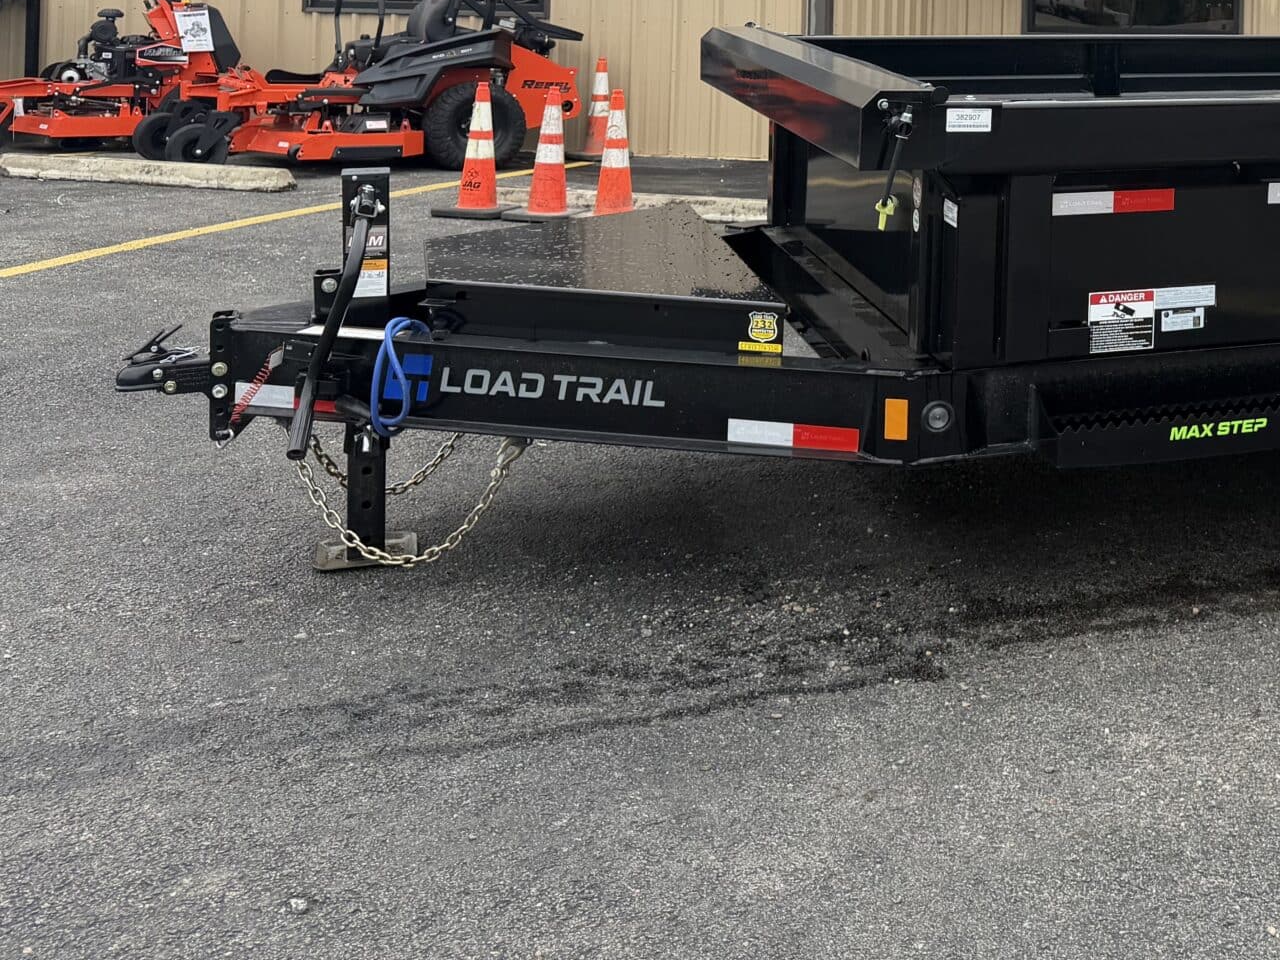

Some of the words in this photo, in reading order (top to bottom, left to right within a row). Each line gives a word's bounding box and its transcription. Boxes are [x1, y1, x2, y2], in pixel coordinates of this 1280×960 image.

[462, 180, 482, 189] JAG
[1108, 292, 1146, 302] DANGER
[440, 367, 545, 399] LOAD
[552, 374, 665, 407] TRAIL
[1170, 423, 1214, 441] MAX
[1216, 418, 1268, 436] STEP
